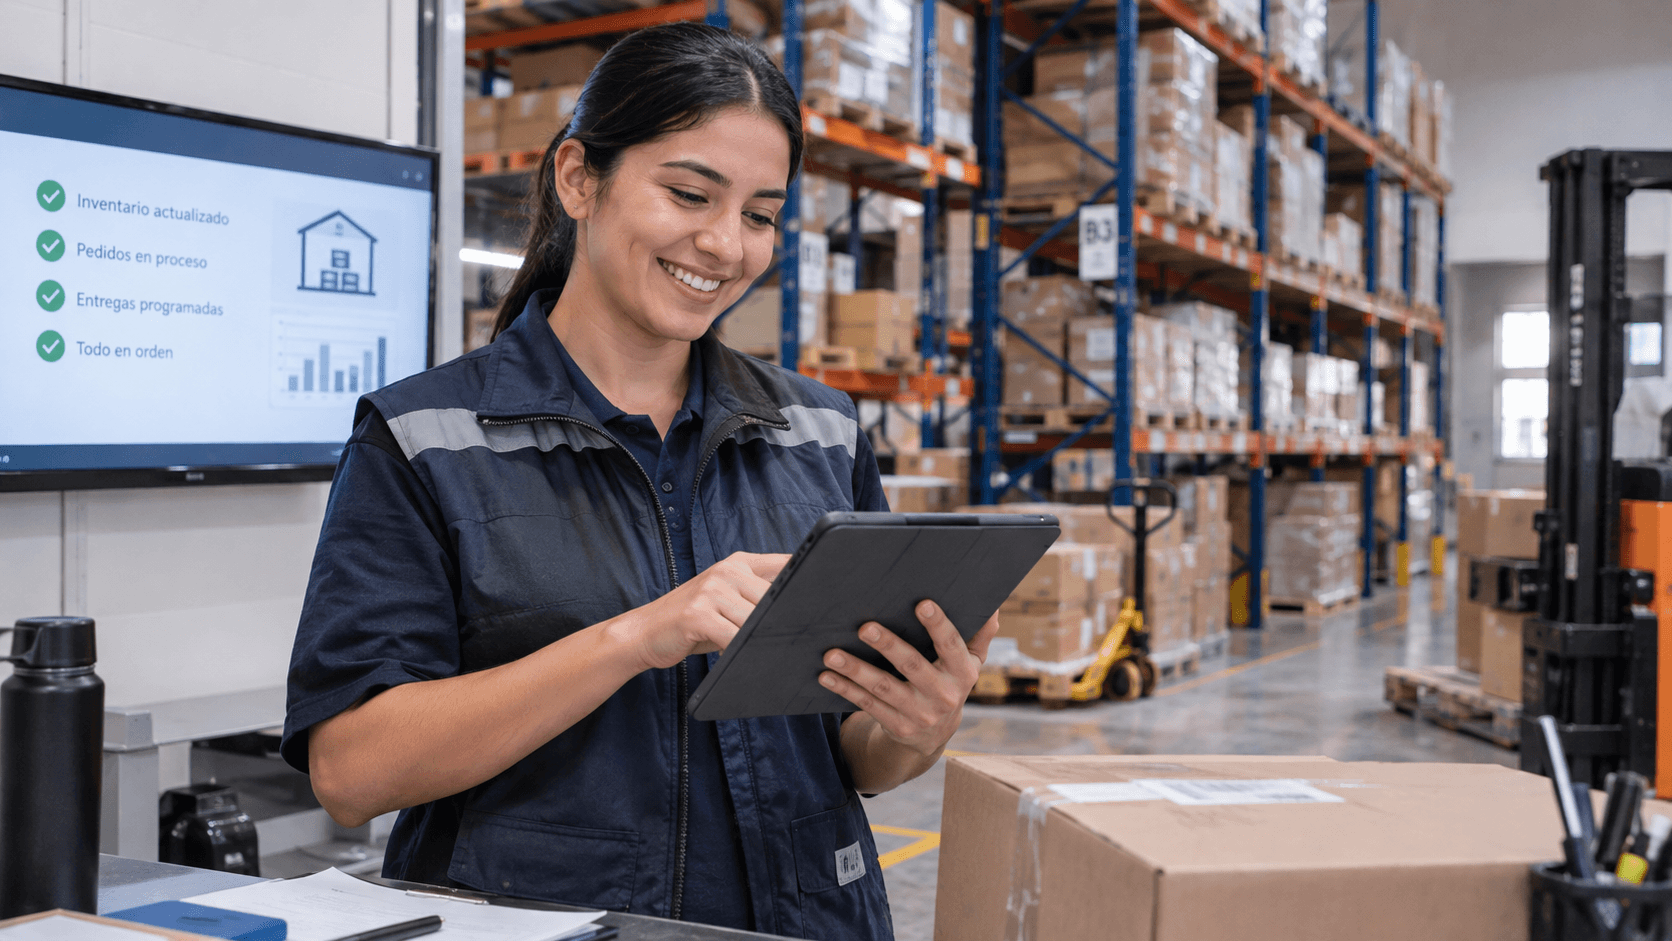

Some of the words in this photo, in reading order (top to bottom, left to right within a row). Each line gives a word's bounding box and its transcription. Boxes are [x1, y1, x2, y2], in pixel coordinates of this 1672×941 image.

[77, 193, 150, 216] Inventario
[153, 206, 230, 226] actualizado
[77, 242, 131, 261] Pedidos
[135, 252, 152, 263] en
[156, 253, 208, 269] proceso
[76, 292, 136, 313] Entregas
[140, 300, 224, 316] programadas
[76, 341, 111, 357] Todo
[114, 346, 131, 357] en
[135, 344, 173, 359] orden
